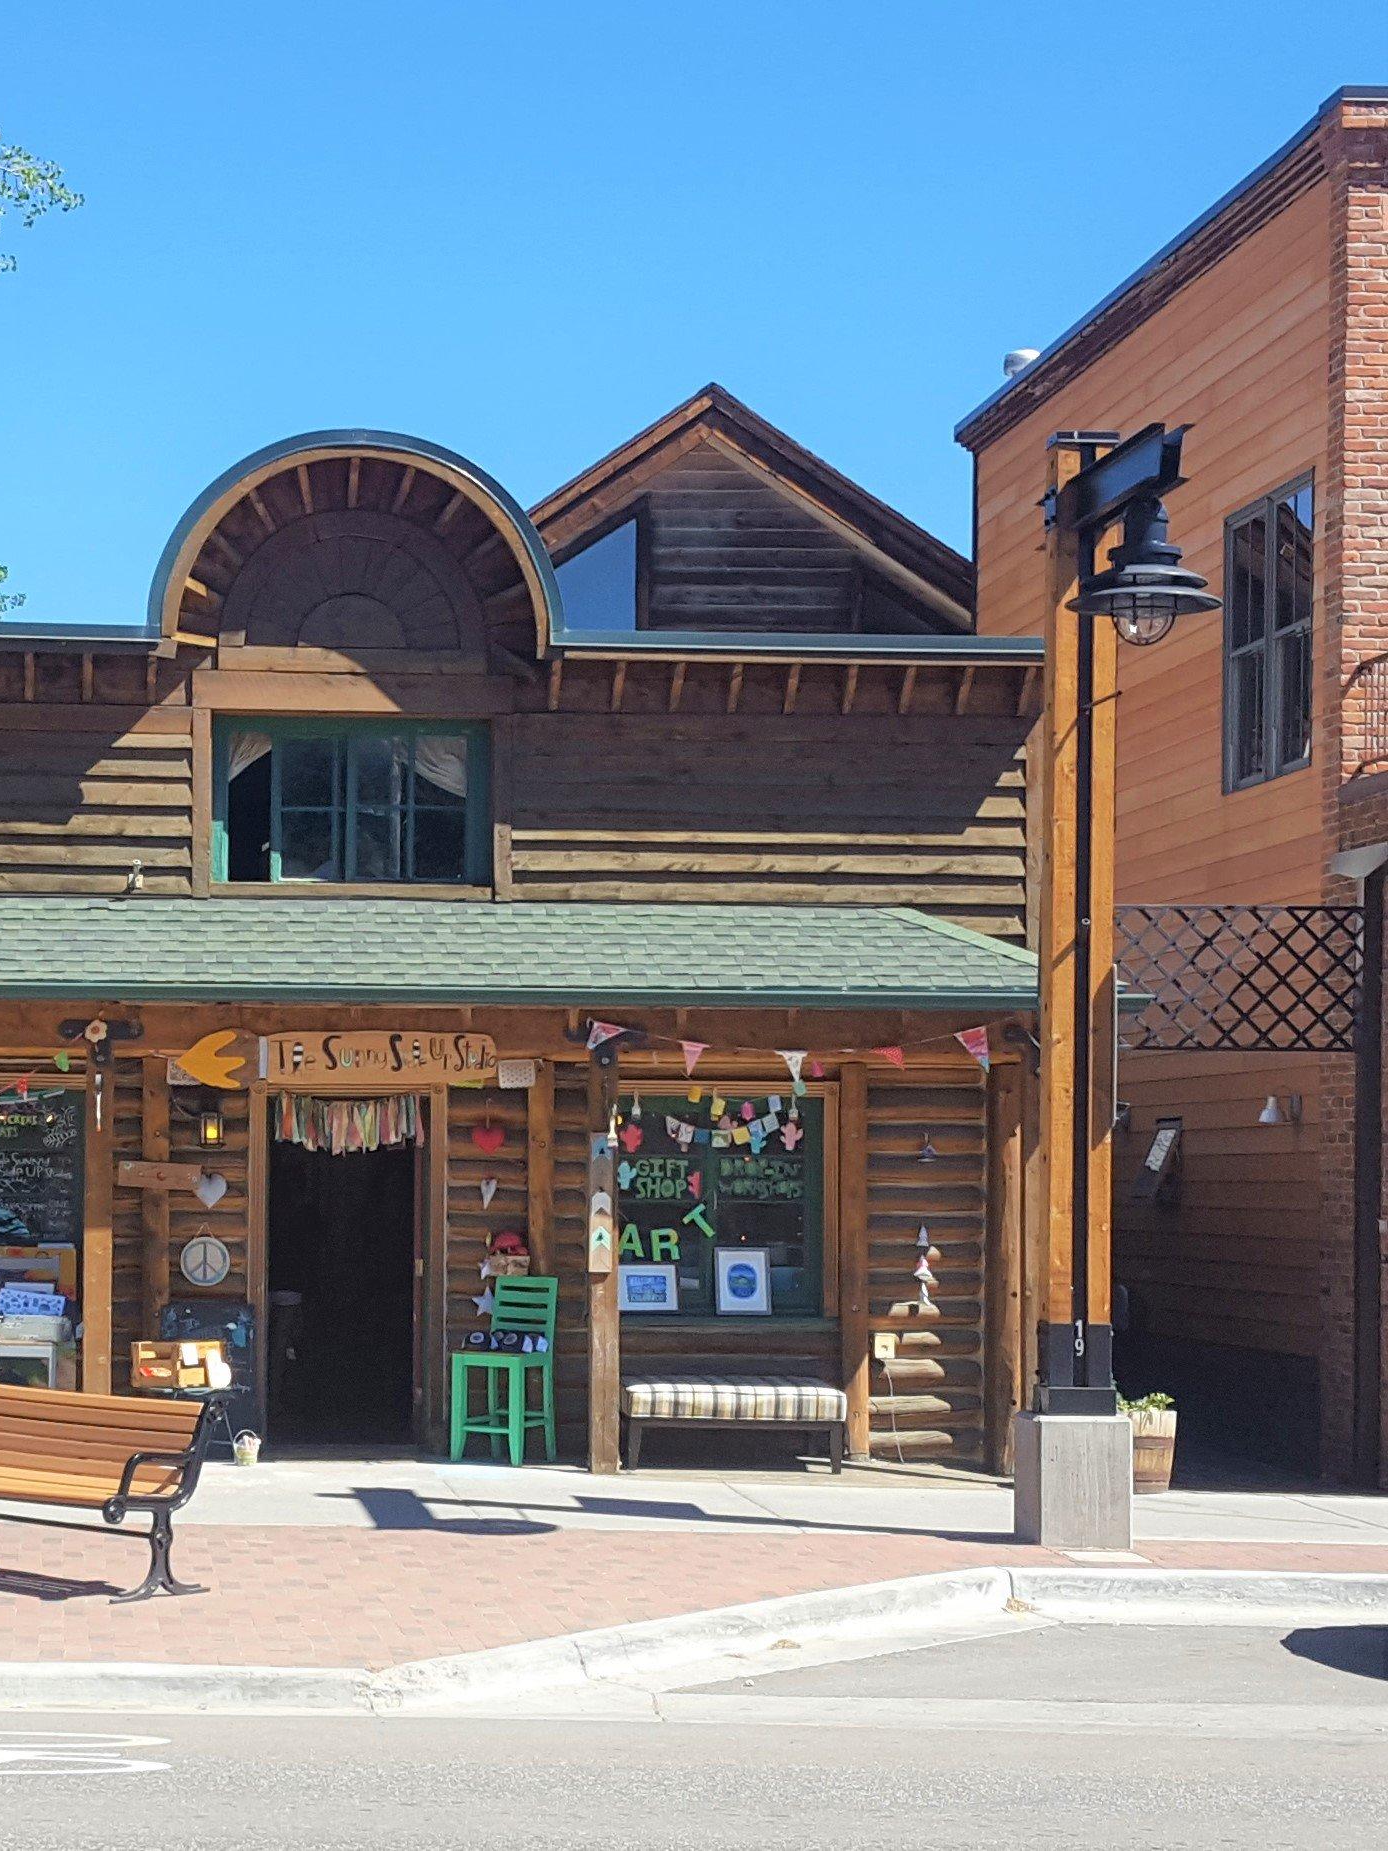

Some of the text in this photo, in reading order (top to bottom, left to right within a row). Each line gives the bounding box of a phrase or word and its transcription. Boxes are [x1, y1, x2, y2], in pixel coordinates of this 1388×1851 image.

[321, 1035, 387, 1071] Sunny
[636, 1158, 688, 1179] GIFT
[635, 1178, 687, 1199] SHOP
[1075, 1319, 1085, 1357] 19
